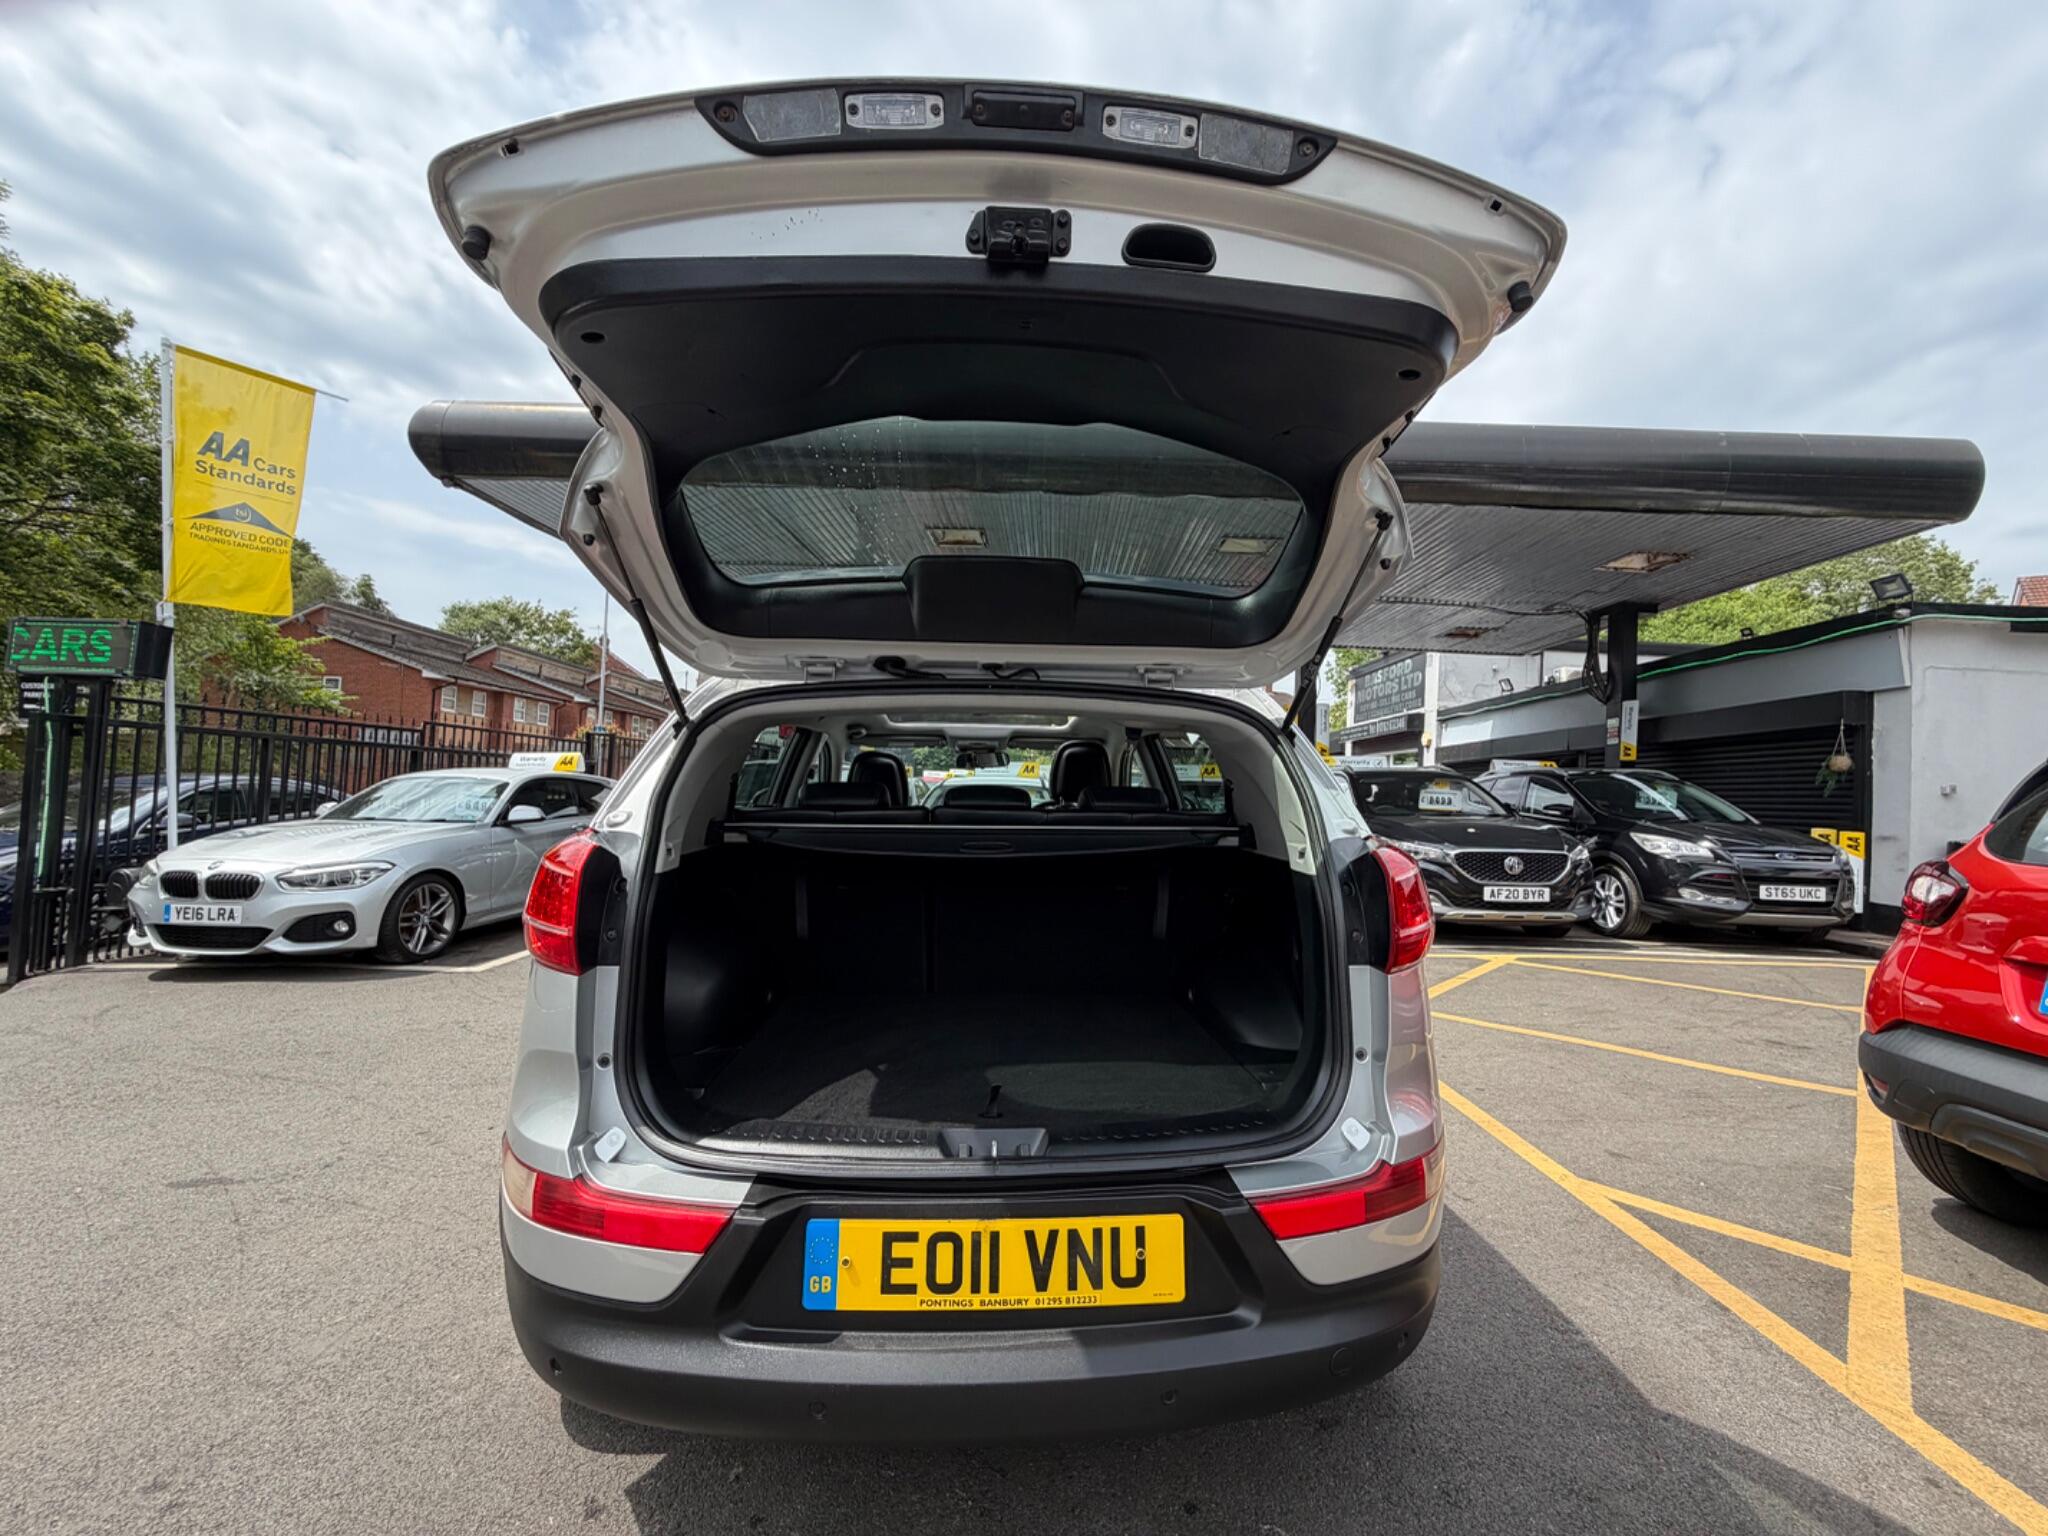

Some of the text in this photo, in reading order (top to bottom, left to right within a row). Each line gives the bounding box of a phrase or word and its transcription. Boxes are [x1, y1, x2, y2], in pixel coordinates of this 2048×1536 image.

[197, 431, 296, 479] AA Cars
[195, 459, 297, 496] Standards
[189, 521, 258, 542] APPROVED
[11, 626, 112, 662] CARS
[1401, 671, 1422, 690] LTD
[1846, 836, 1861, 852] AA
[1489, 888, 1546, 900] AF20 BYR
[1765, 887, 1821, 900] ST65 UKC
[175, 906, 236, 921] YE16 LRA
[1024, 1225, 1146, 1293] VNU
[809, 1275, 832, 1294] GB
[919, 1295, 1098, 1308] PONTINGS BANBURY 01295 812233
